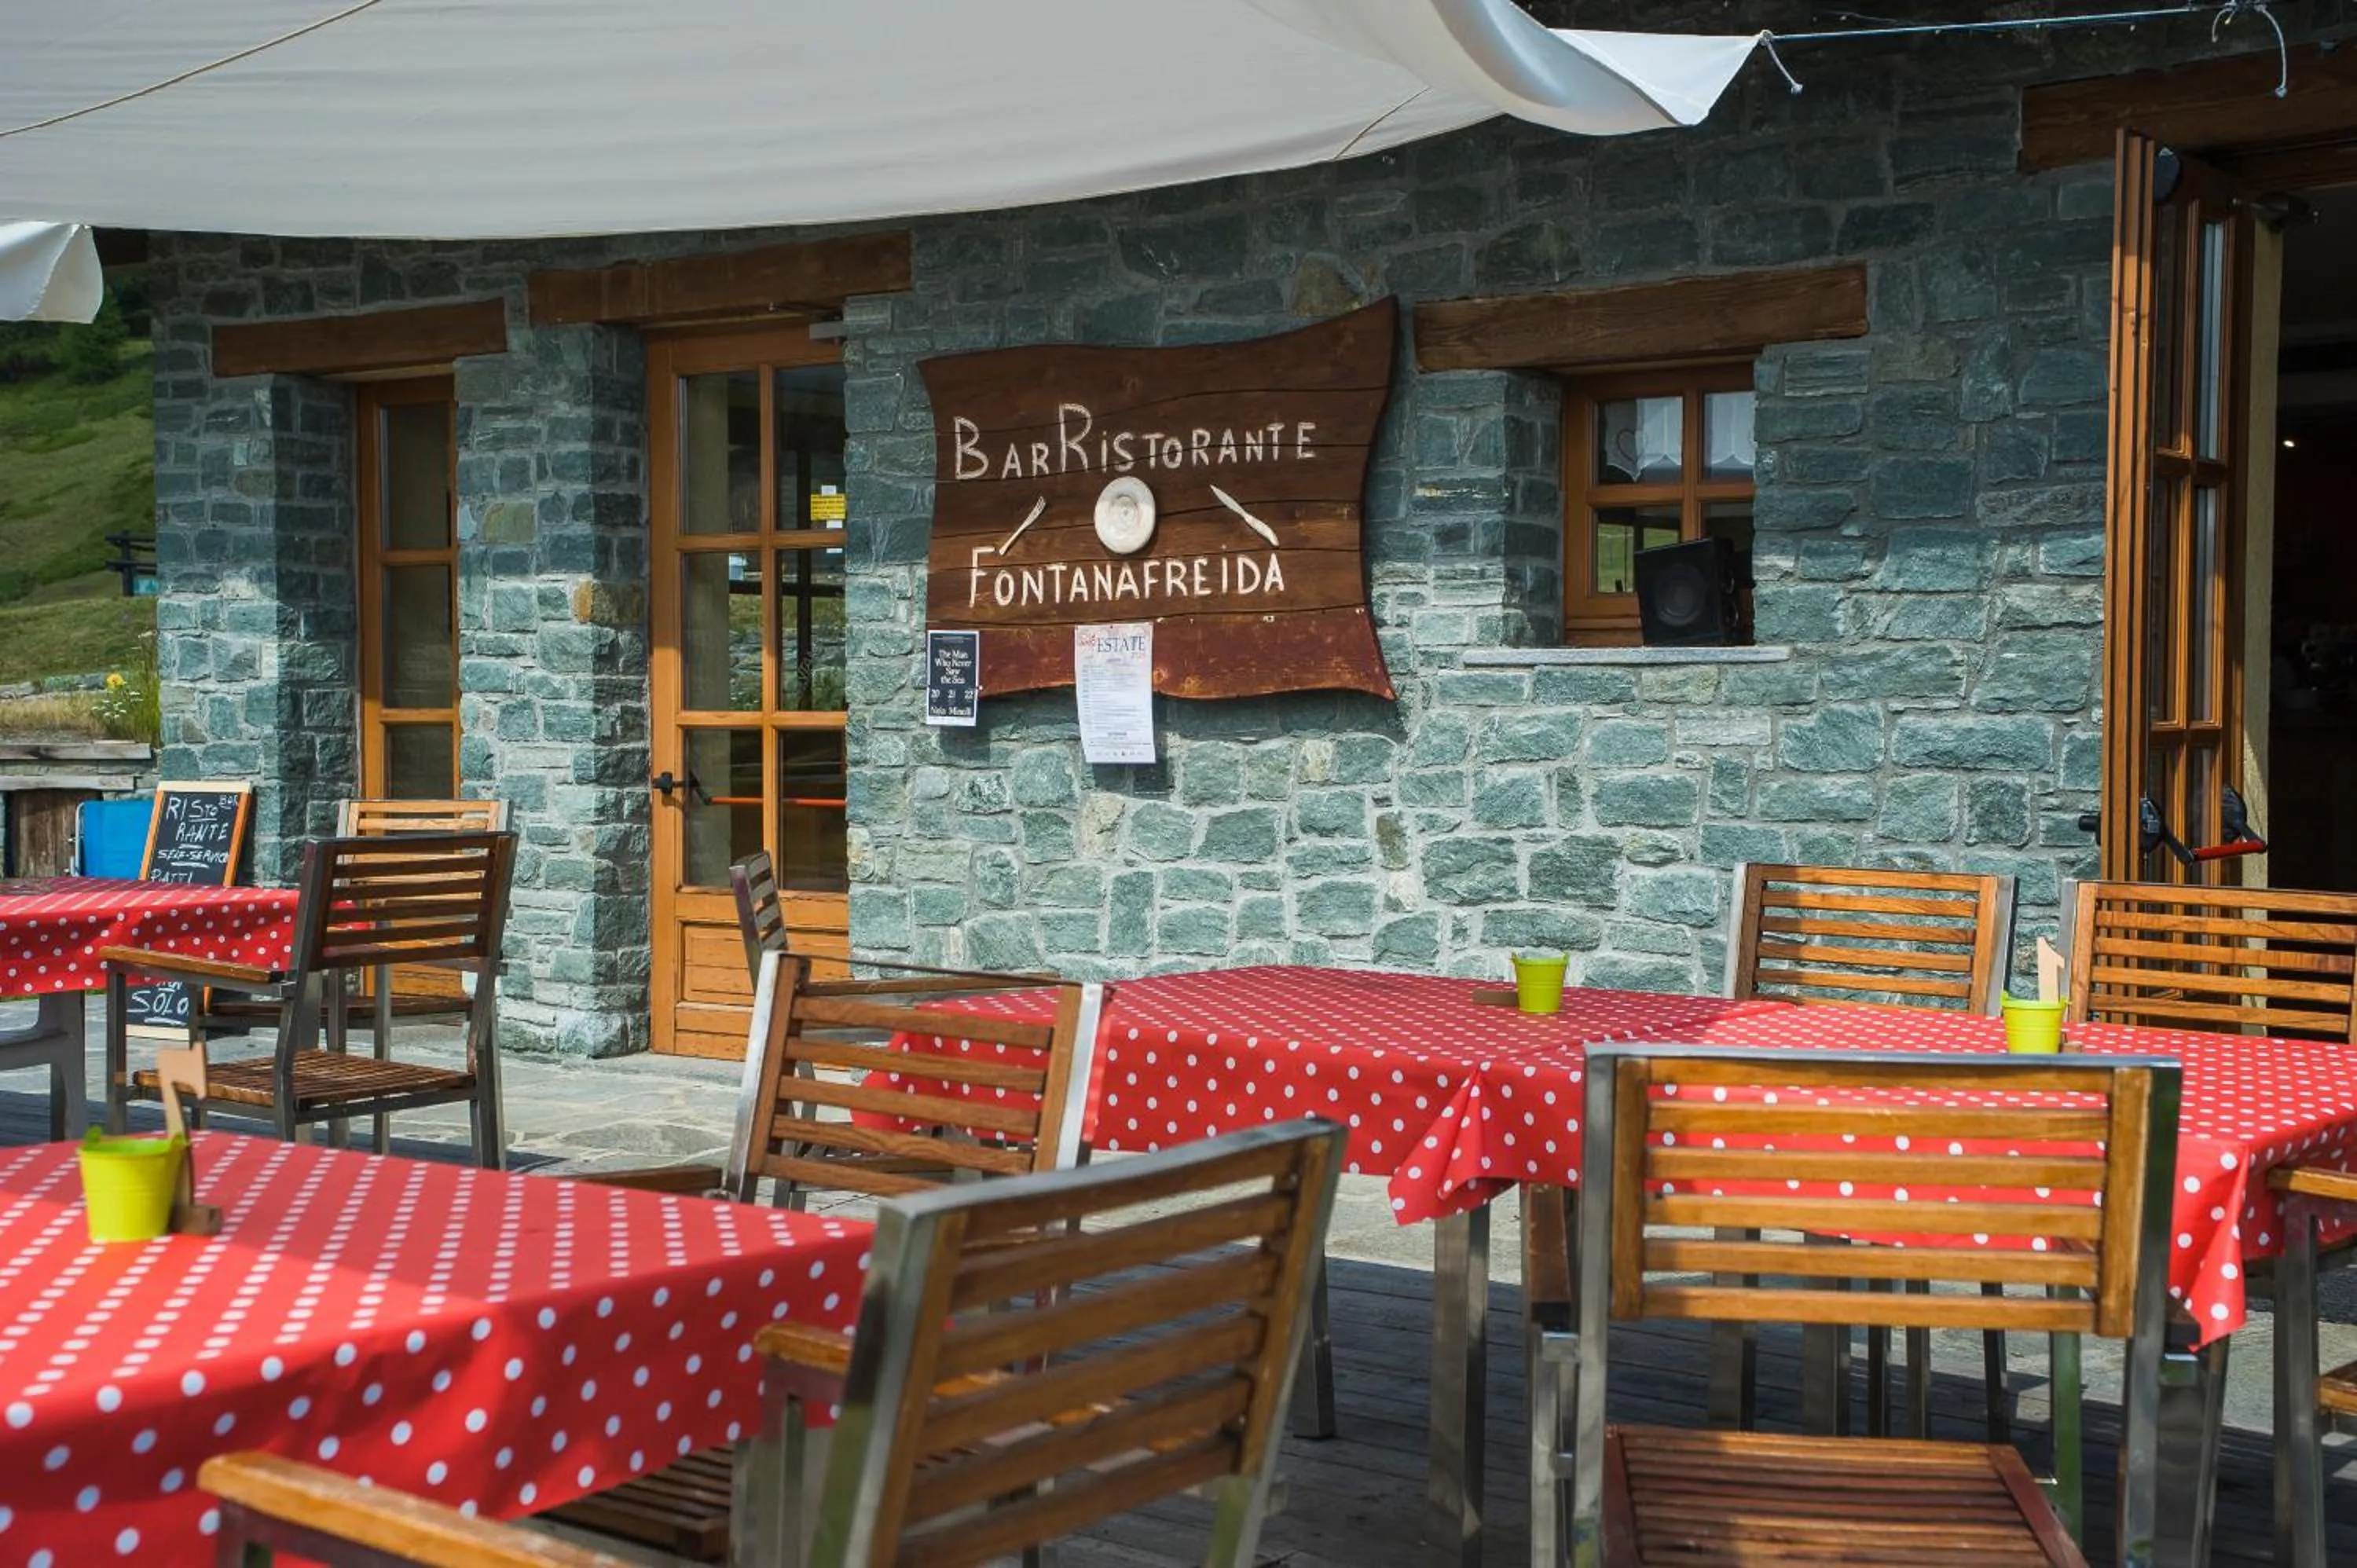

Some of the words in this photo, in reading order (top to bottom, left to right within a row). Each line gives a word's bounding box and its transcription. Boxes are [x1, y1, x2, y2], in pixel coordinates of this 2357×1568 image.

[968, 546, 1285, 608] FONTANAFREIDA
[1098, 636, 1146, 653] ESTATE
[951, 649, 969, 659] Man
[175, 822, 229, 842] RANTE
